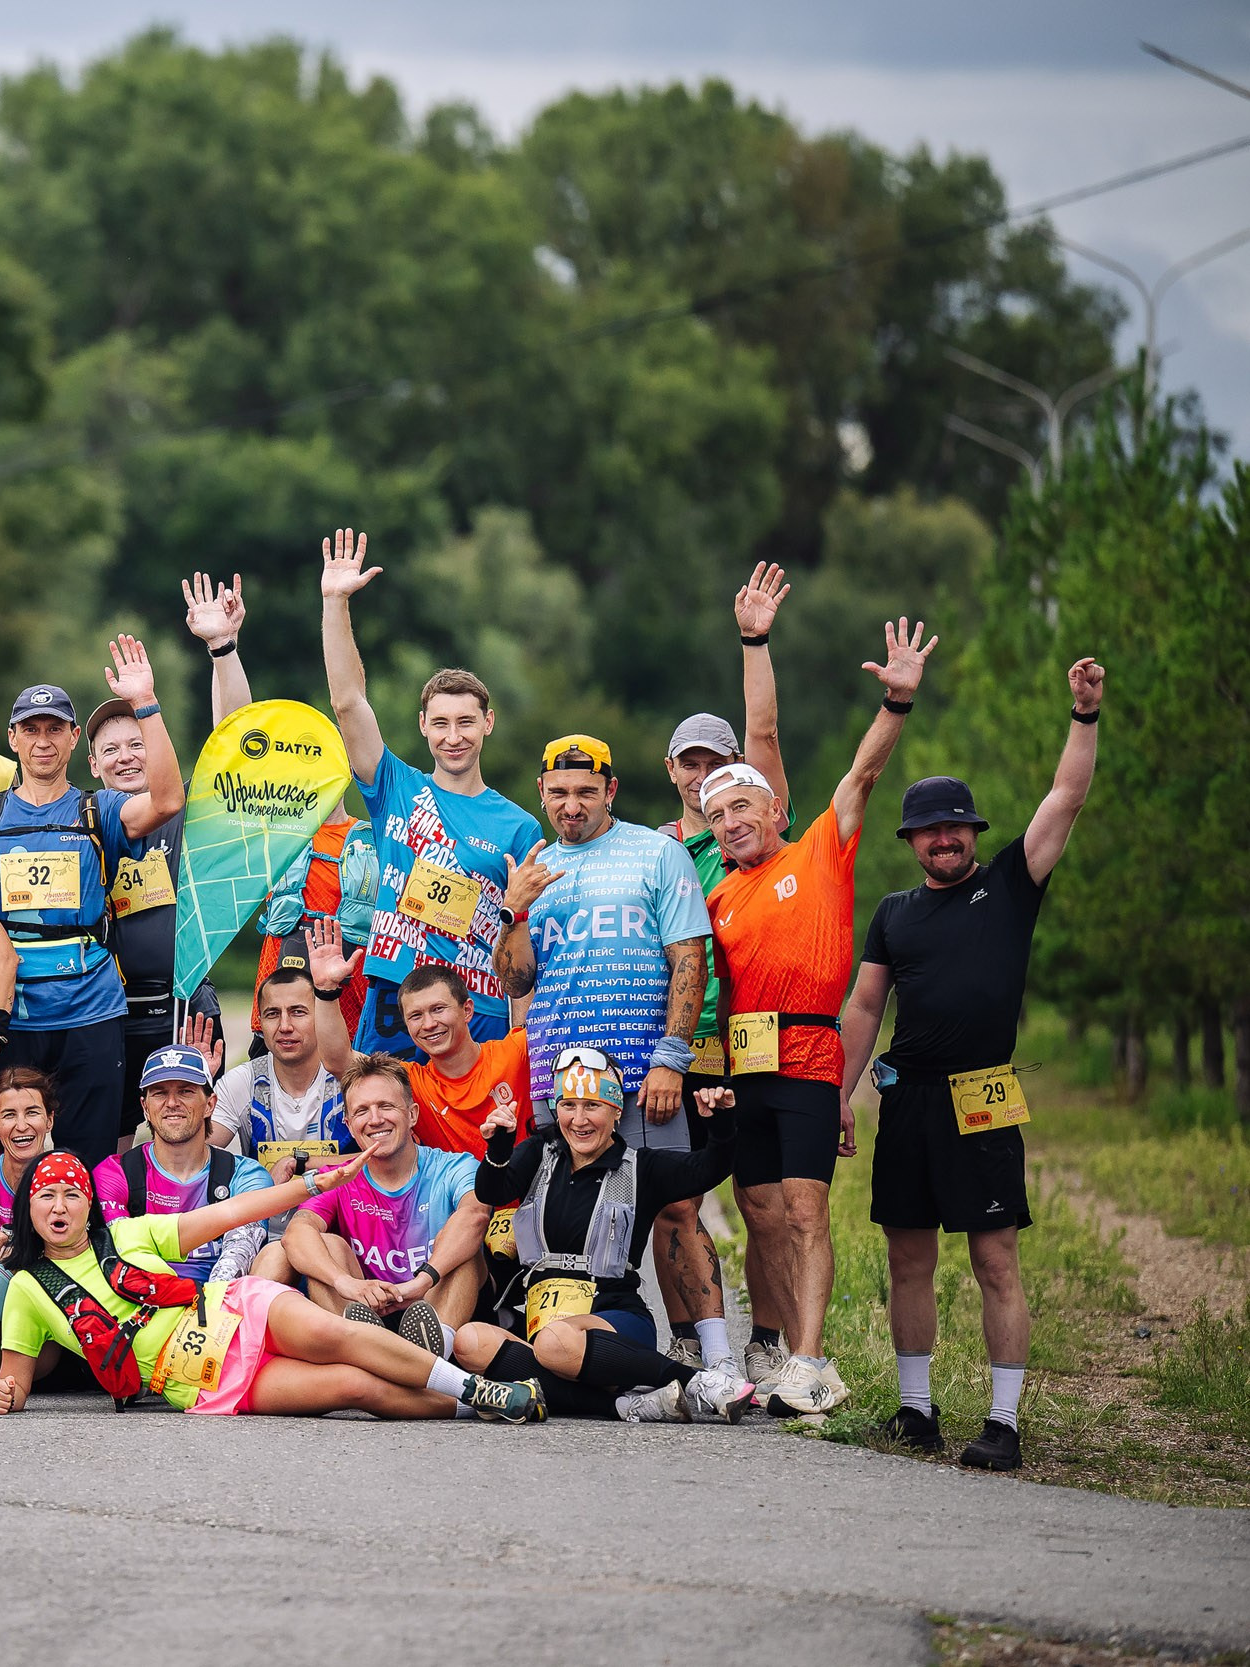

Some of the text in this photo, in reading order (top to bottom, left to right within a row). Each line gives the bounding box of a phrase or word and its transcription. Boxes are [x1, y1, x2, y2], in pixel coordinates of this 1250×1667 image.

[275, 741, 322, 757] BATYR
[214, 771, 318, 813] Уфимское
[248, 803, 305, 823] ожерелье
[615, 860, 630, 869] НА
[28, 865, 51, 886] 32
[120, 869, 144, 891] 34
[560, 874, 608, 891] КИЛОМЕТР
[427, 881, 451, 904] 38
[581, 887, 626, 899] ТРЕБУЕТ
[774, 874, 798, 903] 10
[587, 947, 616, 958] ПЕЙС
[622, 947, 660, 957] ПИТАЙСЯ
[605, 963, 631, 972] ТЕБЯ
[633, 963, 656, 973] ЦЕЛИ
[577, 978, 631, 988] ЧУТЬ-ЧУТЬ
[632, 978, 647, 988] ДО
[584, 993, 628, 1003] ТРЕБУЕТ
[563, 1009, 596, 1021] УГЛОМ
[602, 1008, 649, 1017] НИКАКИХ
[578, 1022, 617, 1034] ВМЕСТЕ
[619, 1022, 657, 1032] ВЕСЕЛЕЕ
[568, 1038, 622, 1049] ПОБЕДИТЬ
[623, 1037, 645, 1046] ТЕБЯ
[733, 1029, 748, 1051] 30
[983, 1082, 1006, 1105] 29
[969, 1115, 980, 1124] 33,1
[490, 1219, 511, 1237] 23
[539, 1290, 560, 1310] 21
[183, 1330, 207, 1356] 33
